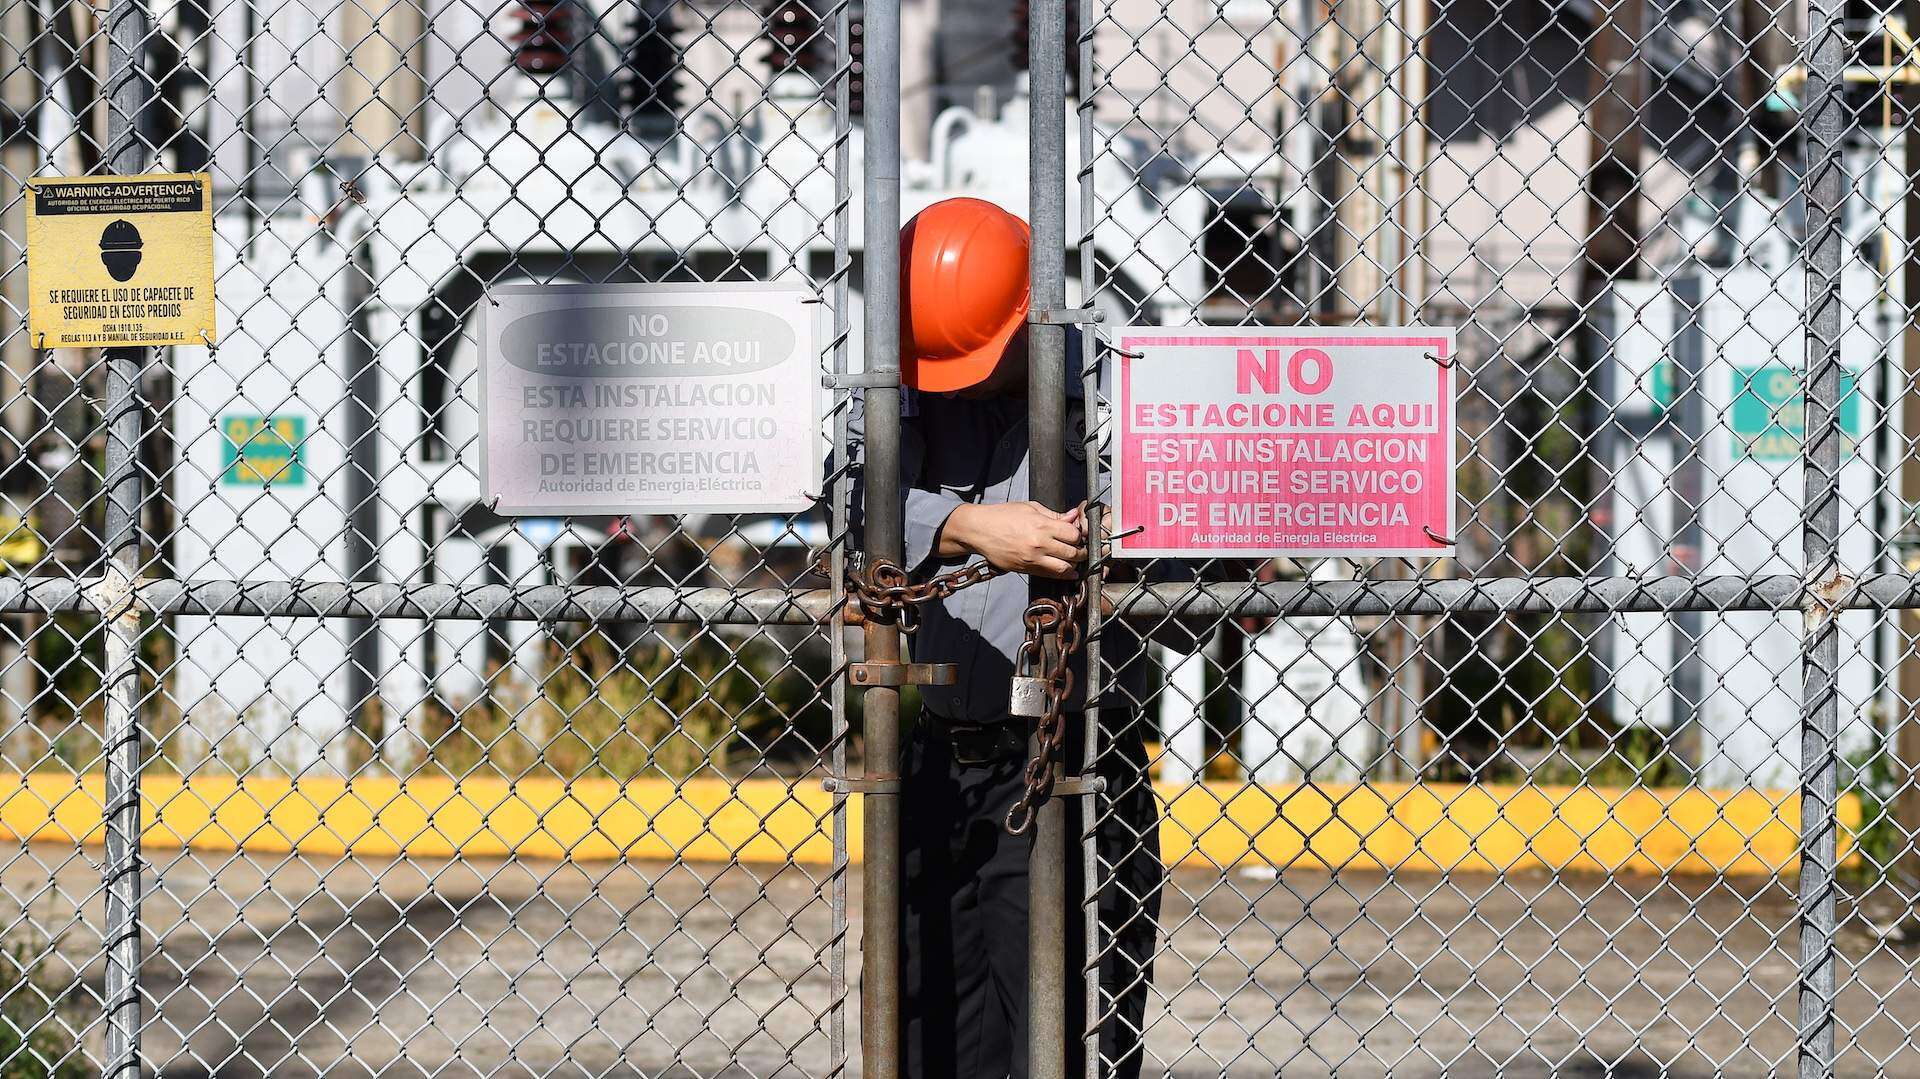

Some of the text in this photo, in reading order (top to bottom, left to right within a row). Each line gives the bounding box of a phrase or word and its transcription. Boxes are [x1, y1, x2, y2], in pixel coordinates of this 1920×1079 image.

[47, 199, 79, 207] AUTORIDAD
[153, 196, 175, 204] PUERTO
[55, 184, 195, 198] WARNING-ADVERTENCIA
[66, 204, 90, 212] OFICINA
[90, 204, 99, 212] DE
[99, 203, 131, 211] SEGURIDAD
[49, 286, 195, 304] SE REQUIERE EL USO DE CAPACETE DE
[63, 303, 181, 319] SEGURIDAD EN ESTOS PREDIOS
[60, 334, 81, 342] REGLAS
[82, 334, 92, 342] 113
[93, 334, 98, 342] A
[102, 333, 107, 341] B
[107, 333, 129, 341] MANUAL
[130, 333, 138, 341] DE
[139, 332, 169, 341] SEGURIDAD
[102, 323, 143, 333] OSHA 1910.135
[628, 314, 669, 337] NO
[537, 341, 760, 366] ESTACIONE AQUI
[1236, 348, 1334, 395] NO
[523, 383, 776, 408] ESTA INSTALACION
[1135, 403, 1433, 429] ESTACIONE AQUI
[523, 416, 778, 444] REQUIERE SERVICIO
[1141, 438, 1427, 463] ESTA INSTALACION
[540, 450, 761, 477] DE EMERGENCIA
[538, 478, 613, 493] Autoridad
[617, 478, 635, 493] de
[699, 477, 762, 492] Eléctrica
[1146, 469, 1424, 495] REQUIRE SERVICO
[1159, 502, 1410, 527] DE EMERGENCIA
[1190, 532, 1251, 544] Autoridad
[1254, 532, 1270, 544] de
[1324, 531, 1377, 544] Eléctrica
